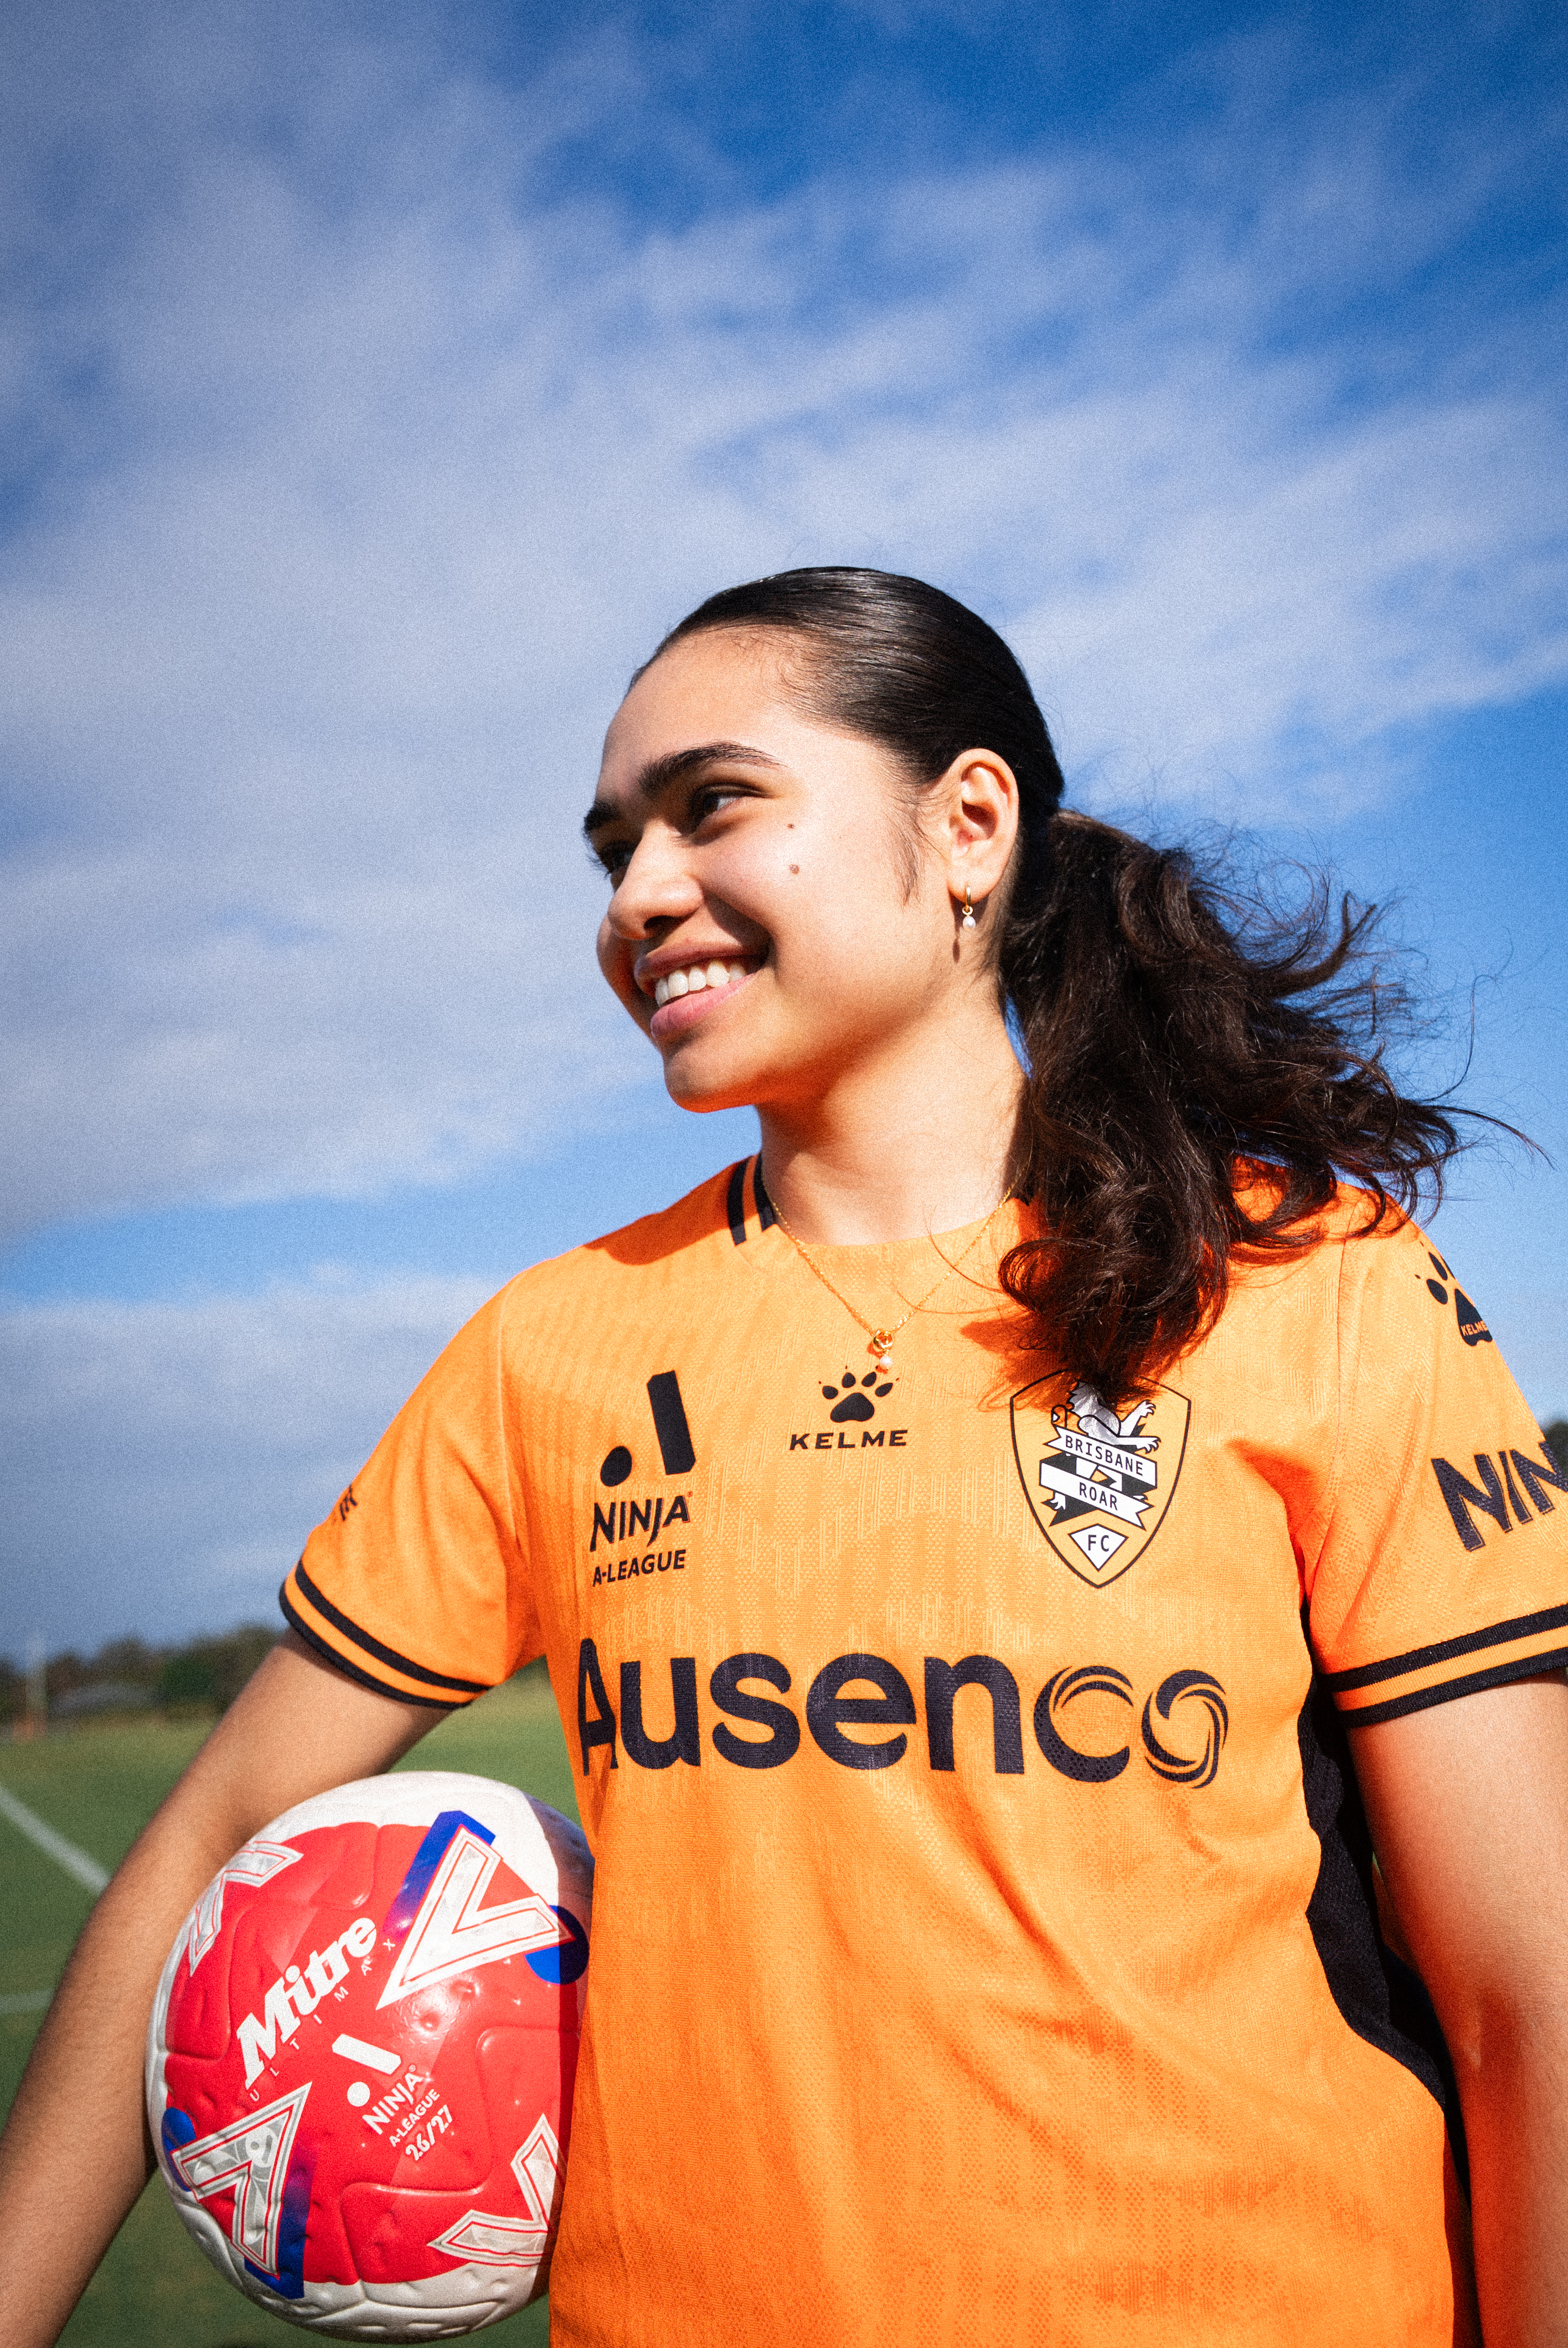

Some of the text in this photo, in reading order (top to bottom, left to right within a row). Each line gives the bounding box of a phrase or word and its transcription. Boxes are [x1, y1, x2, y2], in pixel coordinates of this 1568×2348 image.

[1461, 1320, 1488, 1336] KELME
[790, 1429, 908, 1450] KELME
[1065, 1435, 1144, 1477] BRISBANE
[590, 1495, 690, 1552] NINJA
[1079, 1482, 1118, 1511] ROAR
[592, 1549, 686, 1587] A-LEAGUE
[1087, 1535, 1110, 1552] FC
[577, 1638, 1229, 1789] Ausenco
[236, 1917, 377, 2090] Mitre
[249, 1938, 396, 2102] ULTIMAX
[362, 2073, 424, 2135] NINJA
[389, 2088, 440, 2148] A-LEAGUE
[405, 2104, 453, 2161] 26/27
